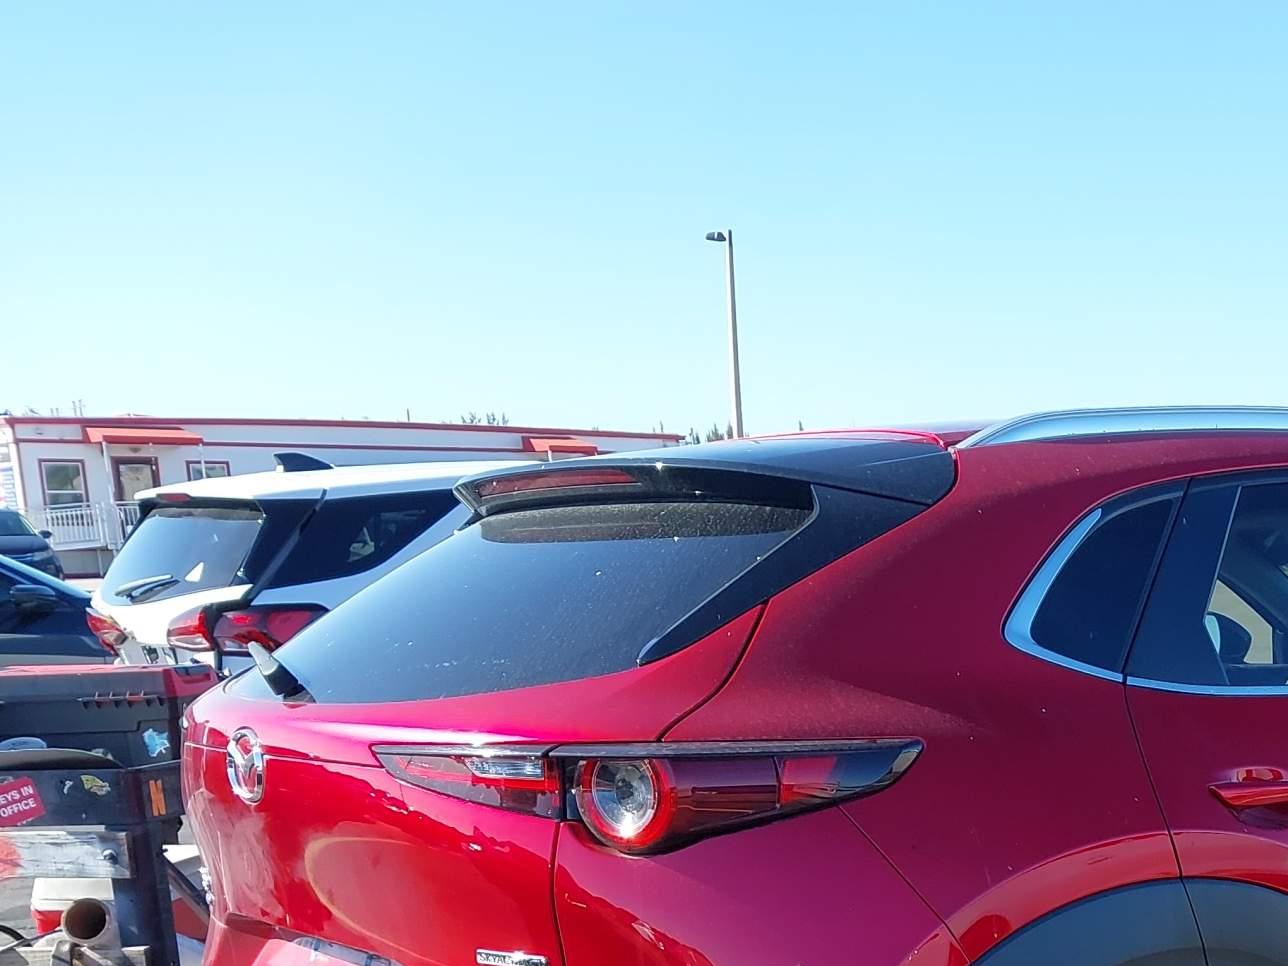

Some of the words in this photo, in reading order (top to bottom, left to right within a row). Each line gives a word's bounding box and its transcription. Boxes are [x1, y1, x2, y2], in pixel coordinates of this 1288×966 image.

[0, 790, 20, 803] EYS
[20, 785, 34, 796] IN
[0, 797, 37, 817] OFFICE
